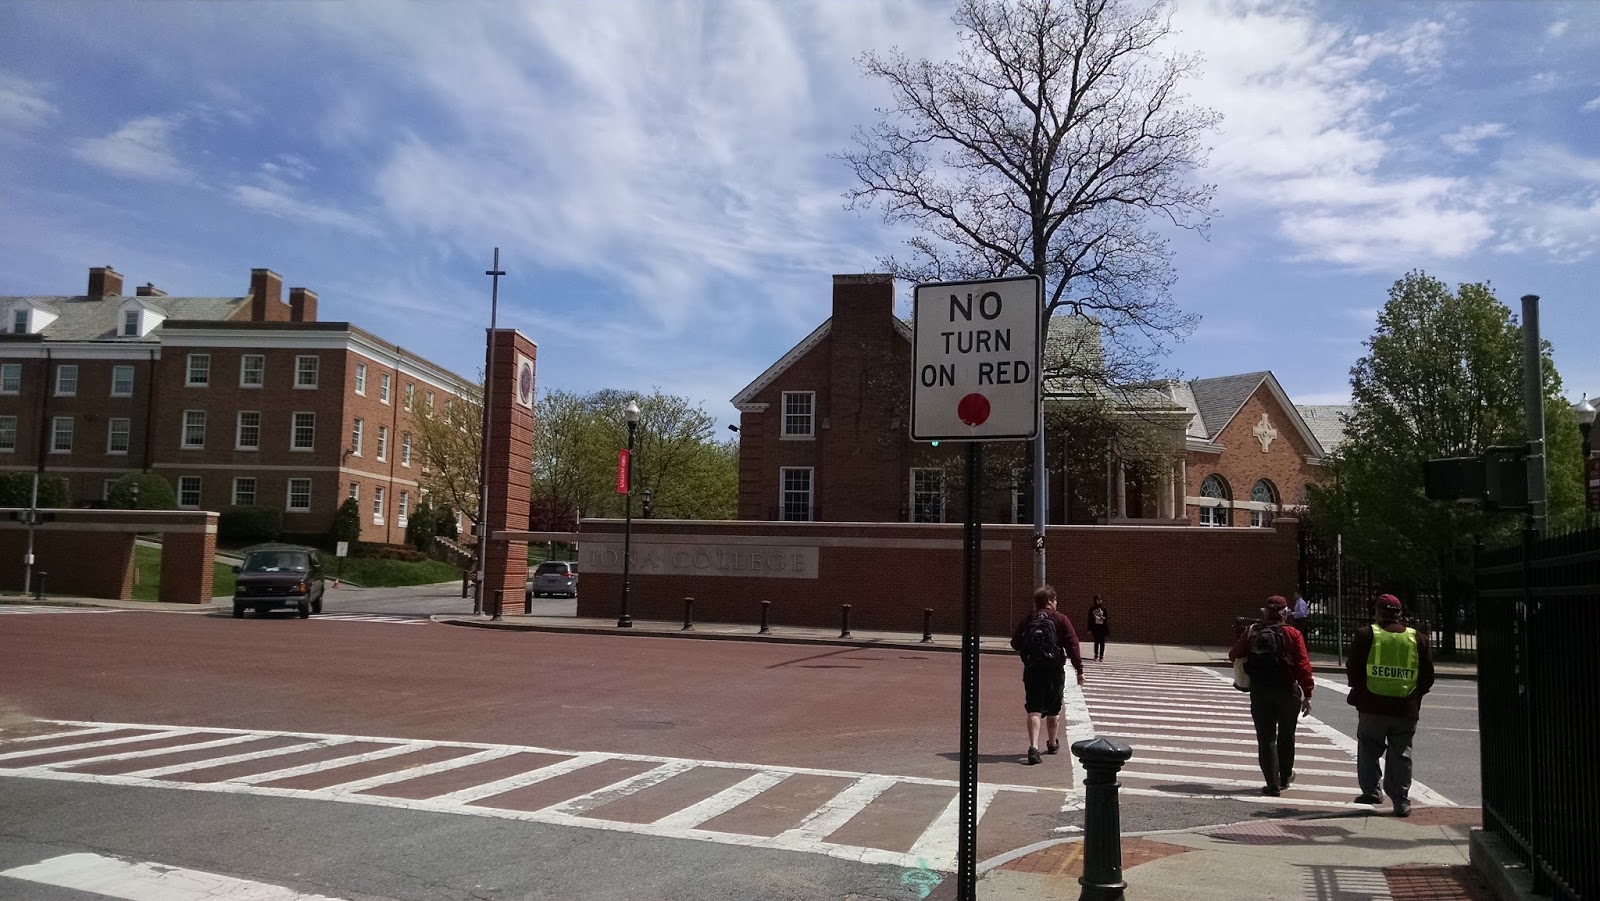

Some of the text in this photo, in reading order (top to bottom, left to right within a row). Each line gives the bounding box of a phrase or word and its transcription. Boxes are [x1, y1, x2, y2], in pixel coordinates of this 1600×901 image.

[949, 291, 1003, 322] NO
[941, 328, 1011, 354] TURN
[921, 360, 1030, 387] ON RED
[590, 550, 806, 571] IONA COLLEGE
[1371, 665, 1416, 679] SECURITY
